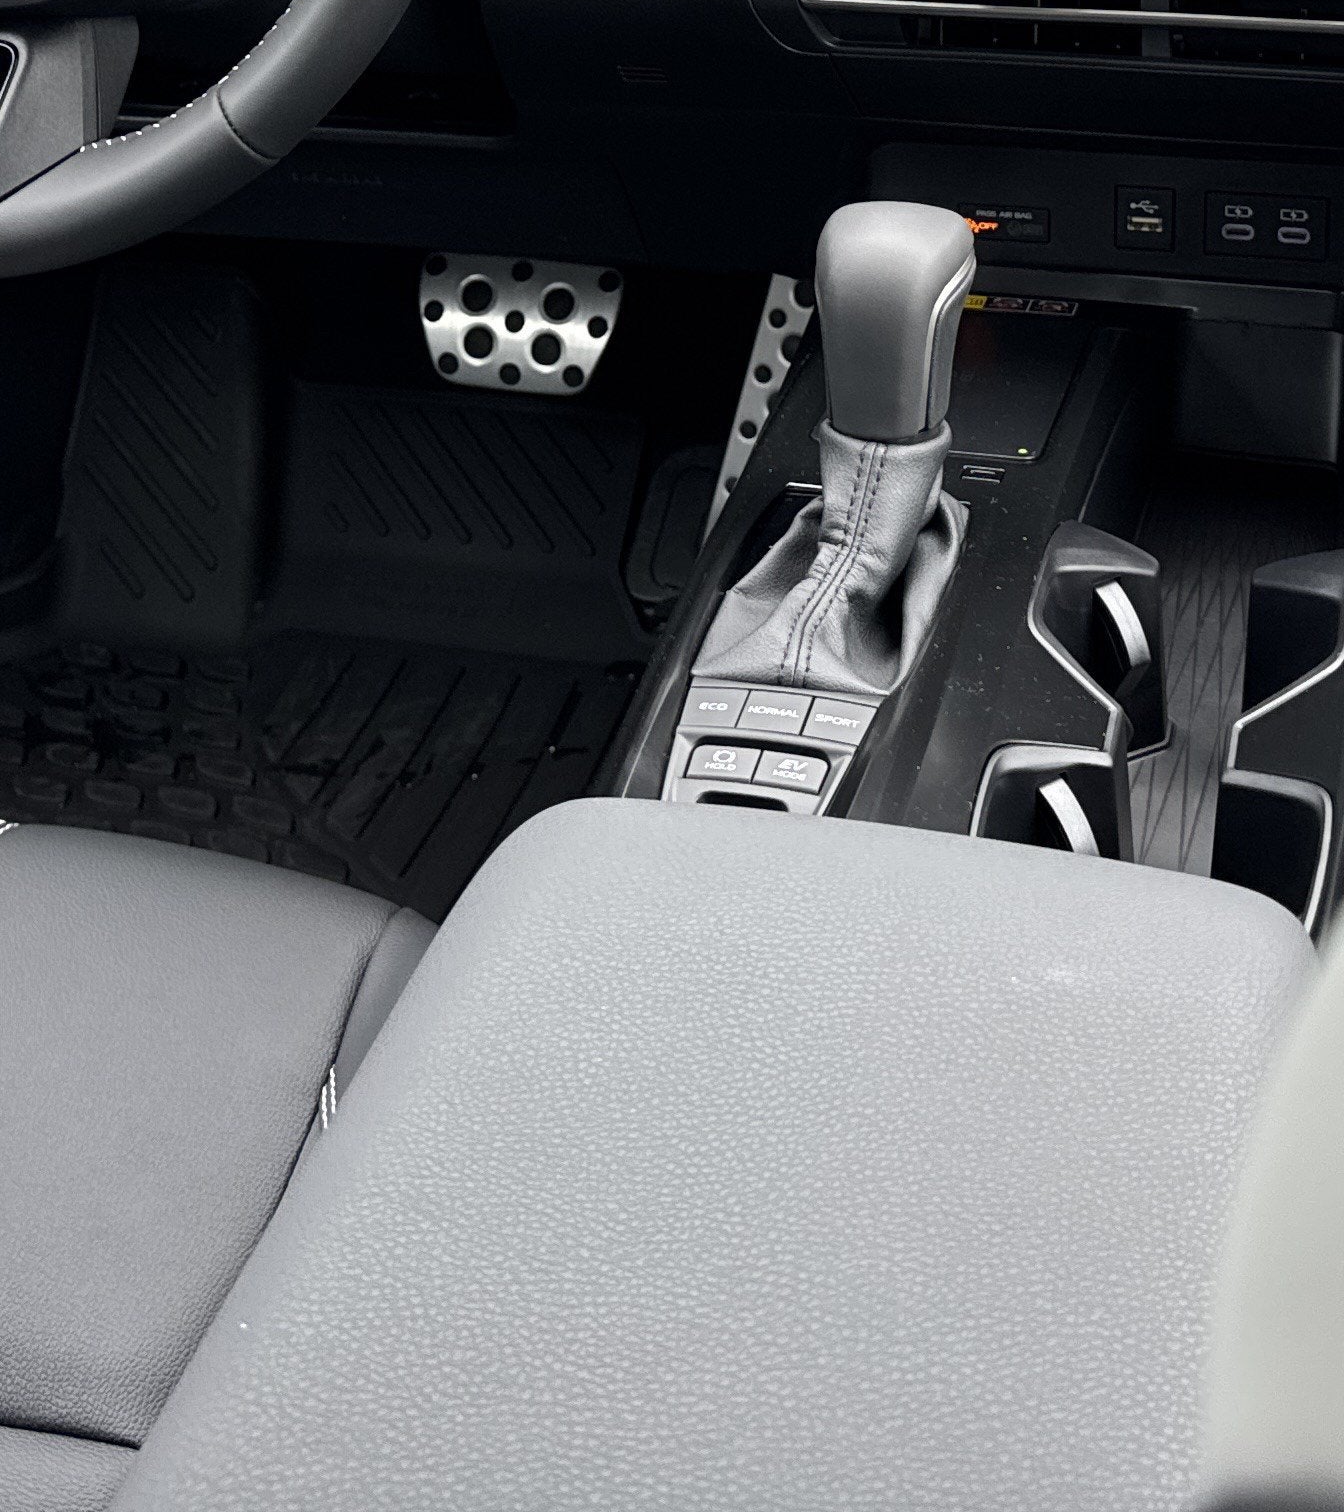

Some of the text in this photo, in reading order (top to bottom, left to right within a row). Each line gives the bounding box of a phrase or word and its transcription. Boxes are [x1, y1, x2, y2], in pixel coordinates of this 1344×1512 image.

[698, 701, 729, 711] ECO
[748, 705, 801, 719] NORMAL
[814, 713, 861, 729] SPORT
[704, 761, 737, 771] HOLD
[778, 758, 809, 771] EV
[772, 769, 807, 782] MODE
